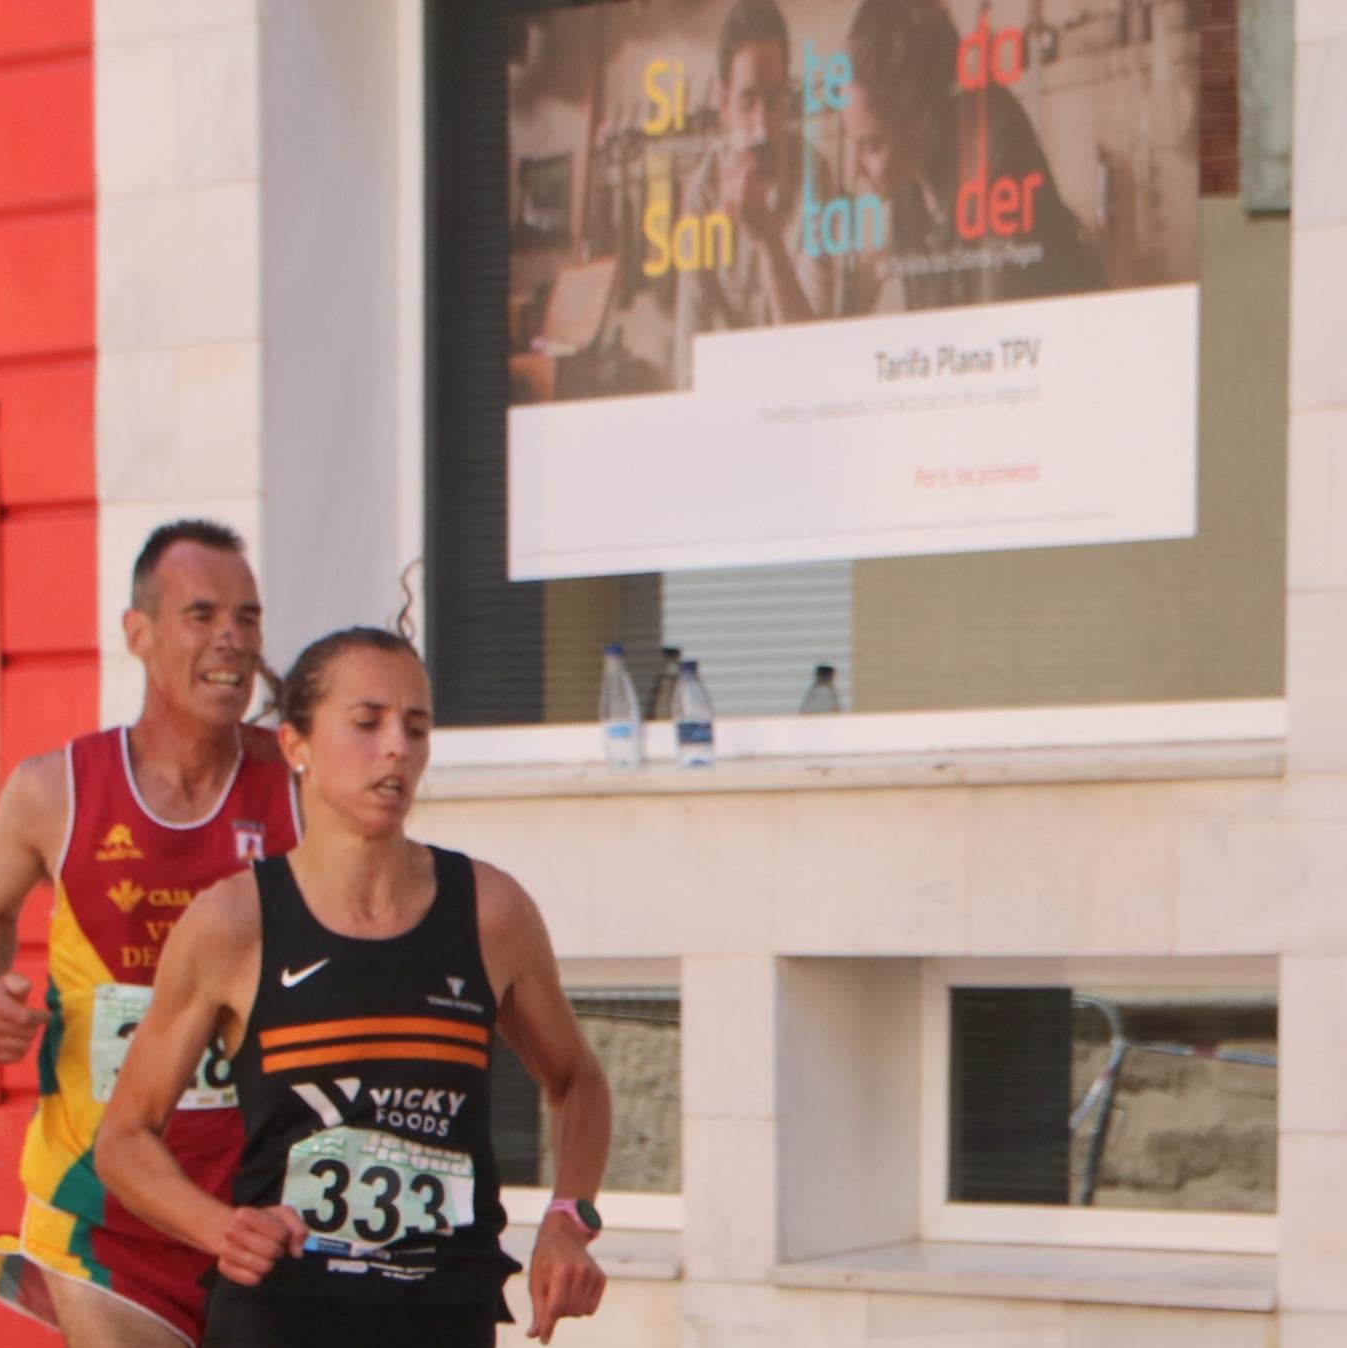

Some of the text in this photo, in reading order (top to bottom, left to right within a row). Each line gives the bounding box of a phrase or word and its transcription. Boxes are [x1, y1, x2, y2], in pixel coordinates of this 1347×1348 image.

[643, 59, 686, 136] Si
[803, 39, 854, 112] te
[643, 170, 1044, 278] San tan der
[875, 338, 1043, 382] Tarifa Plana TPV
[369, 1087, 467, 1117] VICKY
[375, 1108, 450, 1138] FOODS
[302, 1158, 450, 1243] 333
